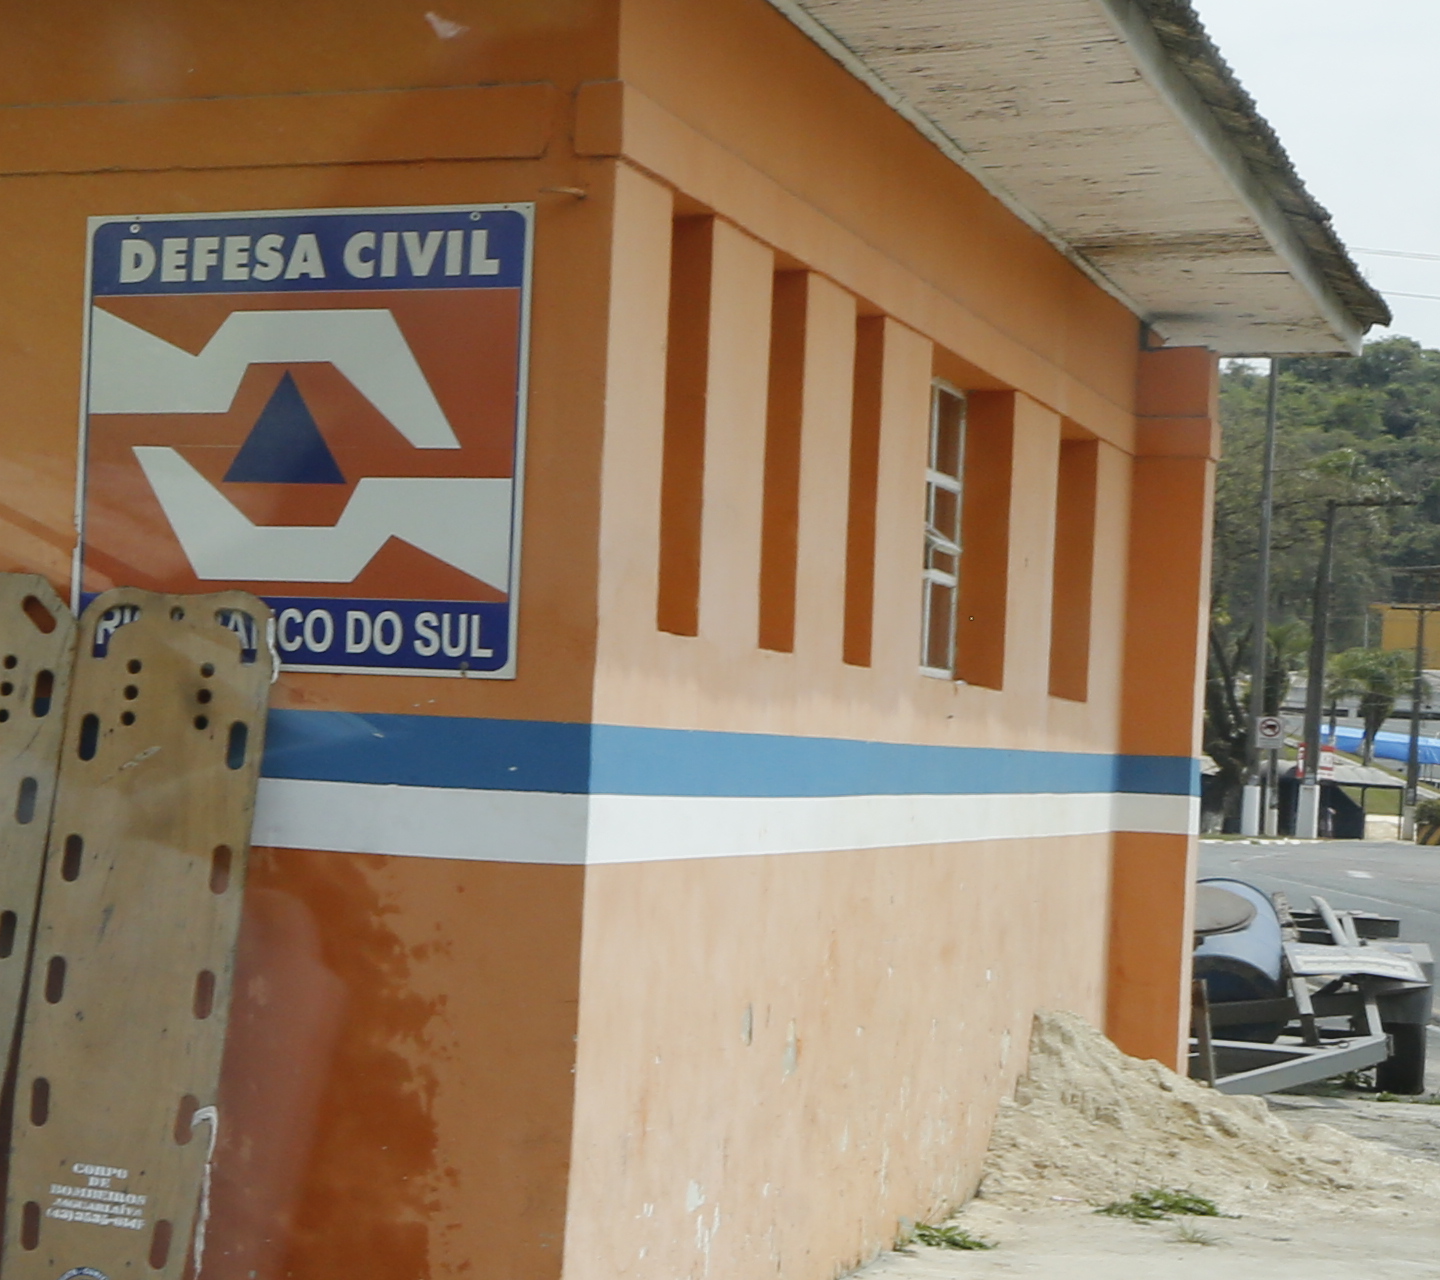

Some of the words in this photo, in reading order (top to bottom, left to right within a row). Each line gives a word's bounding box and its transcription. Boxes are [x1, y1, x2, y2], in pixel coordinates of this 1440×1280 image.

[118, 233, 326, 284] DEFESA
[343, 229, 500, 278] CIVIL
[345, 611, 403, 656] DO
[413, 612, 494, 659] SUL
[72, 1163, 129, 1179] CORPO
[88, 1177, 111, 1188] DE
[49, 1183, 147, 1206] BOMBEIROS
